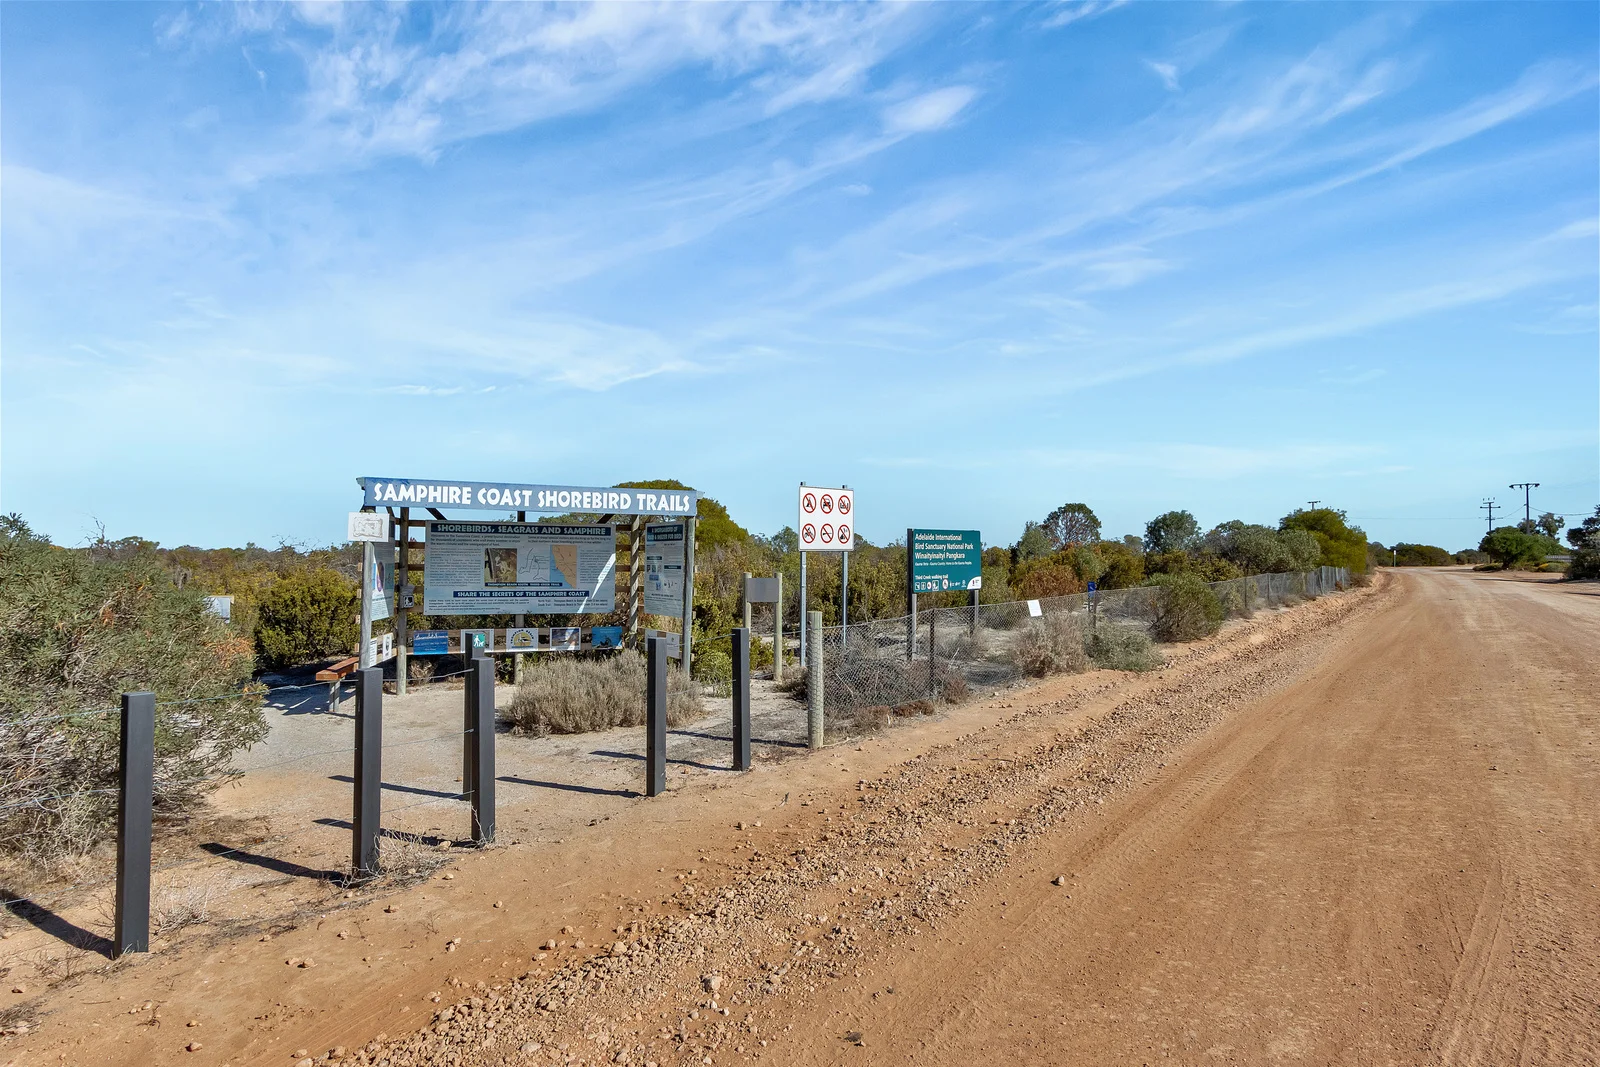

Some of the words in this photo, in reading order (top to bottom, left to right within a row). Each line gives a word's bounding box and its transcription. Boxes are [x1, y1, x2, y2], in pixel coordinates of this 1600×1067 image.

[374, 482, 472, 505] SAMPHIRE
[477, 487, 532, 507] COAST
[537, 490, 632, 510] SHOREBIRD
[636, 493, 690, 512] TRAILS
[437, 524, 495, 533] SHOREBIRDS,
[498, 525, 539, 534] SEAGRASS
[541, 526, 562, 534] AND
[563, 527, 606, 535] SAMPHIRE
[925, 542, 946, 551] Sanctuary
[946, 552, 965, 560] Pangkara
